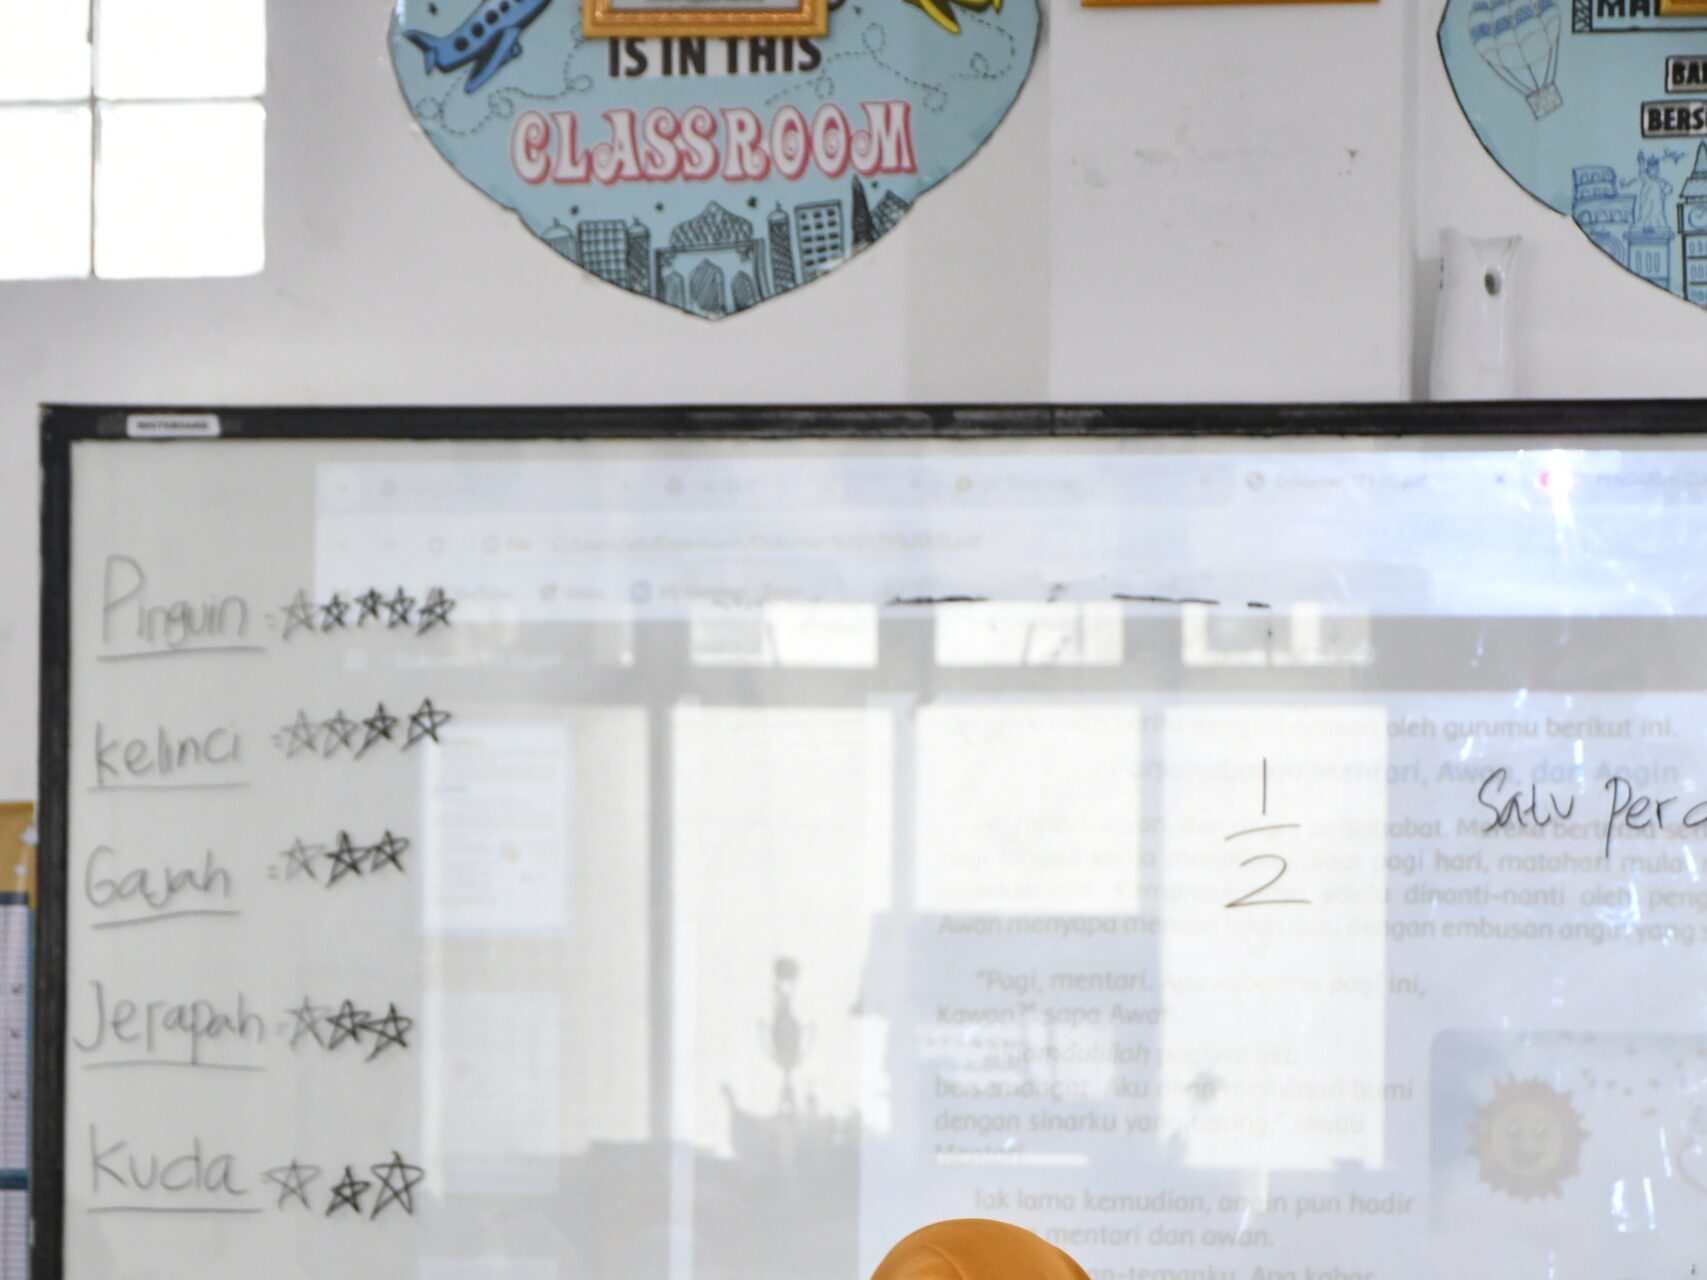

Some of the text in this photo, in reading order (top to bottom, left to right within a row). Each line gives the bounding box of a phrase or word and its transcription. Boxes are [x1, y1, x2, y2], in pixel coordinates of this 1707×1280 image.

[1597, 0, 1661, 17] MA
[608, 37, 822, 77] IS IN THIS
[1647, 107, 1707, 131] BERS
[511, 101, 918, 186] CLASSROOM
[1443, 720, 1538, 742] gurumu
[1546, 716, 1632, 738] berikut
[1224, 853, 1312, 909] 2
[88, 1121, 250, 1197] Kuda
